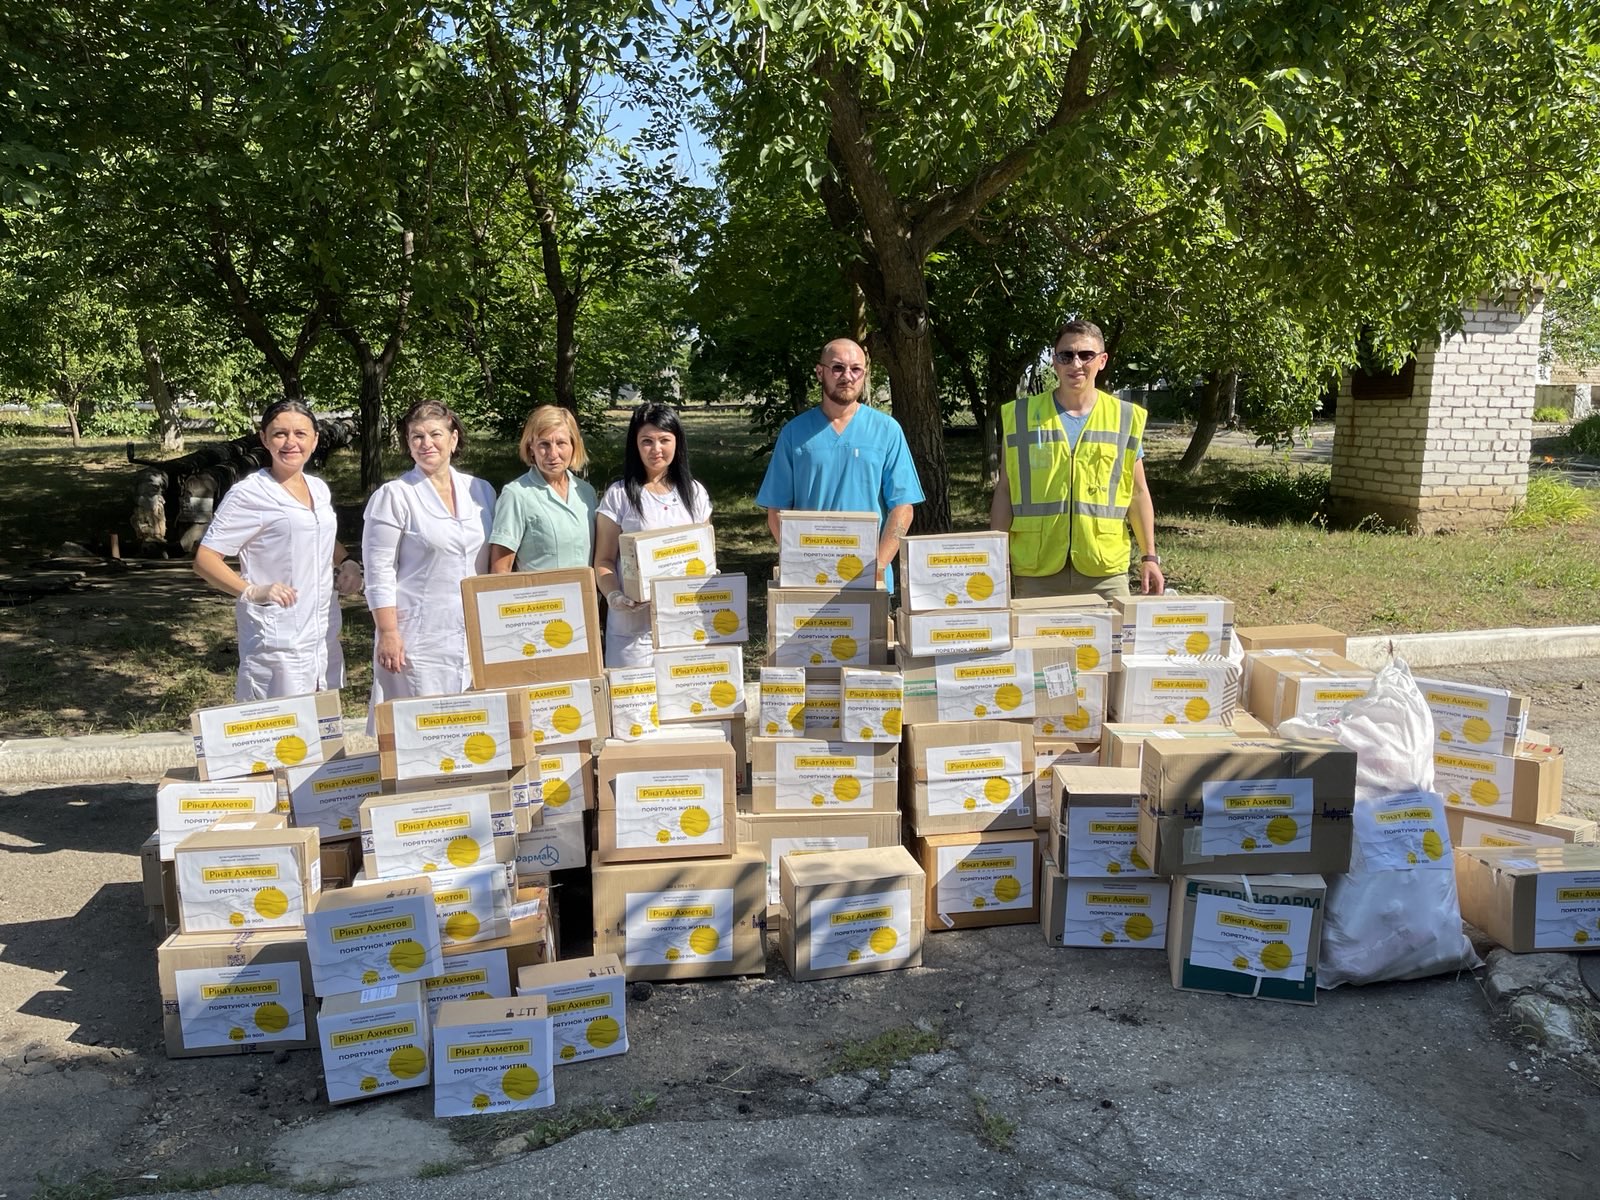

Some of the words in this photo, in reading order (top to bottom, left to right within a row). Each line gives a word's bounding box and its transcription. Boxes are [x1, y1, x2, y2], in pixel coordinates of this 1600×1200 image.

[699, 593, 727, 602] Ахметов
[505, 606, 525, 615] Рінат
[526, 602, 559, 612] Ахметов
[505, 620, 540, 628] ПОРЯТУНОК
[695, 665, 724, 673] Ахметов
[980, 667, 1010, 675] Ахметов
[534, 687, 567, 697] Ахметов
[635, 685, 656, 694] Ахмет
[232, 723, 254, 732] Рінат
[255, 717, 291, 729] Ахметов
[423, 717, 444, 726] Рінат
[446, 713, 482, 724] Ахметов
[233, 737, 271, 747] ПОРЯТУНОК
[423, 733, 461, 741] ПОРЯТУНОК
[319, 781, 340, 791] Рінат
[341, 776, 374, 788] Ахметов
[643, 789, 662, 797] Рінат
[665, 788, 698, 796] Ахметов
[187, 802, 209, 810] Рінат
[212, 801, 248, 809] Ахметов
[320, 795, 356, 805] ПОРЯТУНОК
[402, 822, 425, 832] Рінат
[426, 816, 464, 829] Ахметов
[403, 837, 443, 847] ПОРЯТУНОК
[444, 833, 468, 841] ЖИТТІВ
[981, 860, 1010, 868] Ахметов
[210, 870, 232, 879] Рінат
[234, 868, 272, 878] Ахметов
[1564, 891, 1582, 899] Рінат
[675, 908, 708, 917] Ахметов
[339, 927, 364, 939] Рінат
[366, 919, 407, 934] Ахметов
[1224, 916, 1246, 926] Рінат
[1248, 918, 1283, 931] Ахметов
[1221, 932, 1259, 942] ПОРЯТУНОК
[1261, 936, 1284, 945] ЖИТТІВ
[340, 942, 384, 956] ПОРЯТУНОК
[386, 936, 412, 947] ЖИТТІВ
[426, 979, 441, 990] нат
[444, 973, 480, 986] Ахметов
[209, 987, 233, 996] Рінат
[235, 984, 273, 994] Ахметов
[428, 994, 458, 1006] РЯТУНОК
[460, 990, 484, 999] ЖИТТІВ
[209, 1003, 251, 1011] ПОРЯТУНОК
[548, 1003, 566, 1014] інат
[568, 997, 605, 1010] Ахметов
[553, 1018, 582, 1030] РЯТУНОК
[584, 1013, 608, 1022] ЖИТТІВ
[339, 1032, 364, 1044] Рінат
[367, 1025, 409, 1039] Ахметов
[339, 1048, 384, 1061] ПОРЯТУНОК
[386, 1042, 413, 1052] ЖИТТІВ
[456, 1047, 480, 1058] Рінат
[483, 1043, 524, 1055] Ахметов
[454, 1065, 498, 1075] ПОРЯТУНОК
[501, 1062, 527, 1070] ЖИТТІВ
